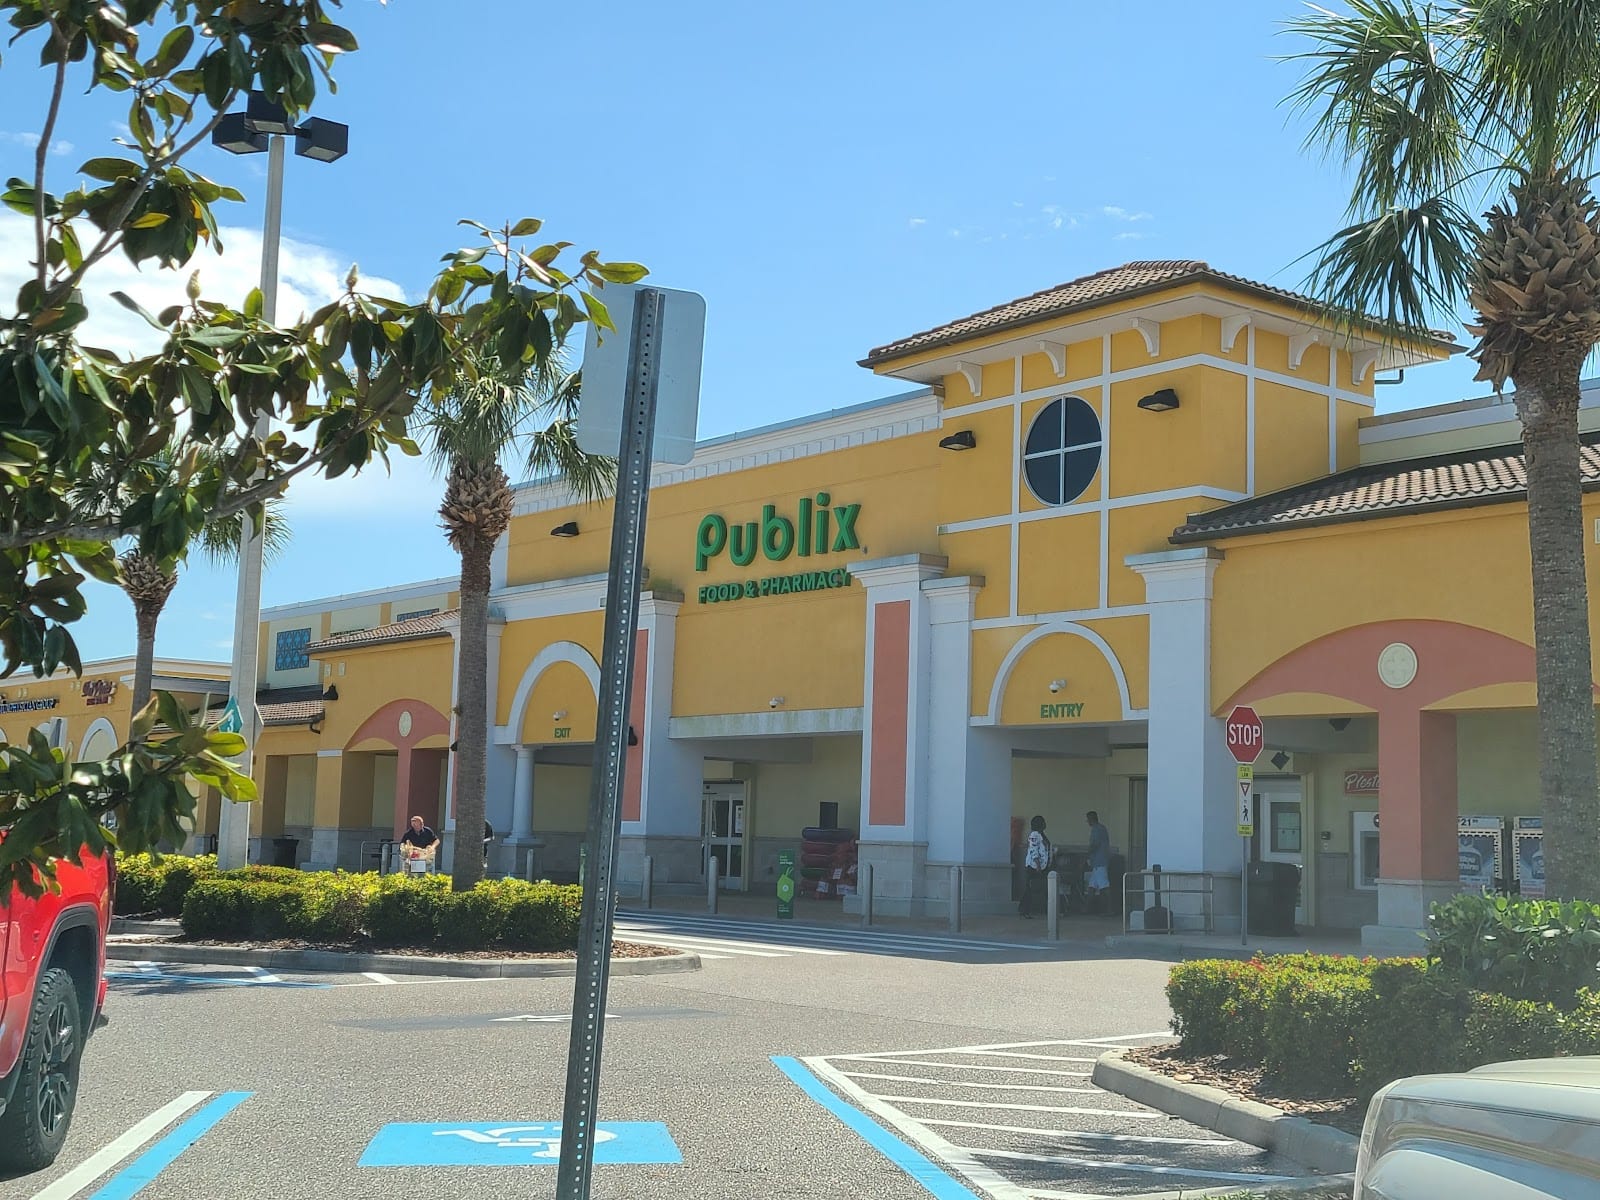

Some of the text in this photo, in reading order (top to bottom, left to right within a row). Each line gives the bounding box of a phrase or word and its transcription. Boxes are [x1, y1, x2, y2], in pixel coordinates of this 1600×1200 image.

[695, 491, 861, 572] Publix
[698, 568, 851, 604] FOOD & PHARMACY
[1040, 702, 1085, 719] ENTRY
[554, 727, 571, 738] EXIT
[1228, 723, 1261, 746] STOP
